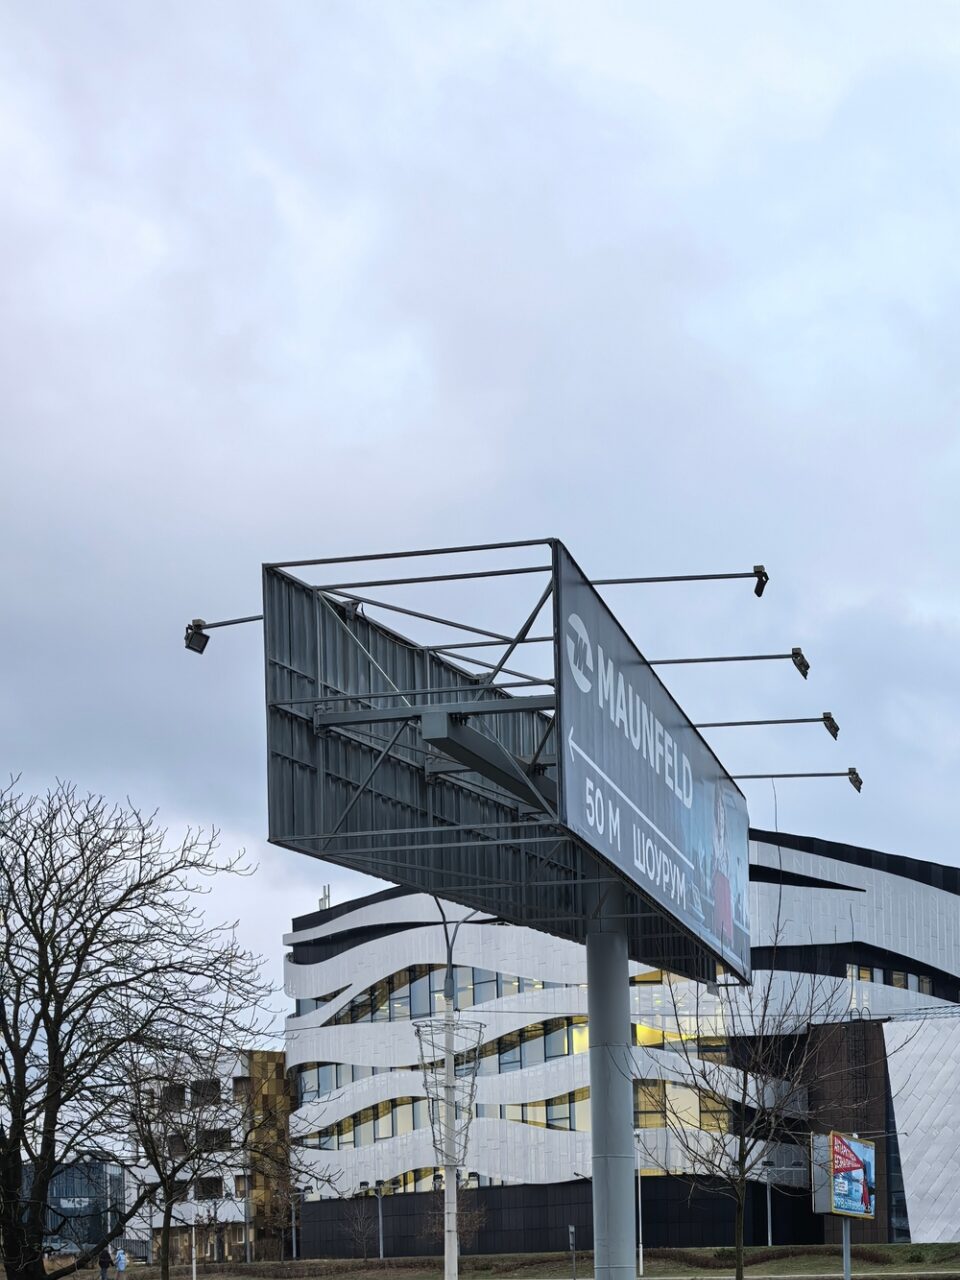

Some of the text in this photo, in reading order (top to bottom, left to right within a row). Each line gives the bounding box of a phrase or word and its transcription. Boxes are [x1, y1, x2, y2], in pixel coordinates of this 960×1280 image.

[597, 644, 694, 809] MAUNFELD
[585, 777, 605, 835] 50
[632, 823, 687, 911] ШОУРУМ
